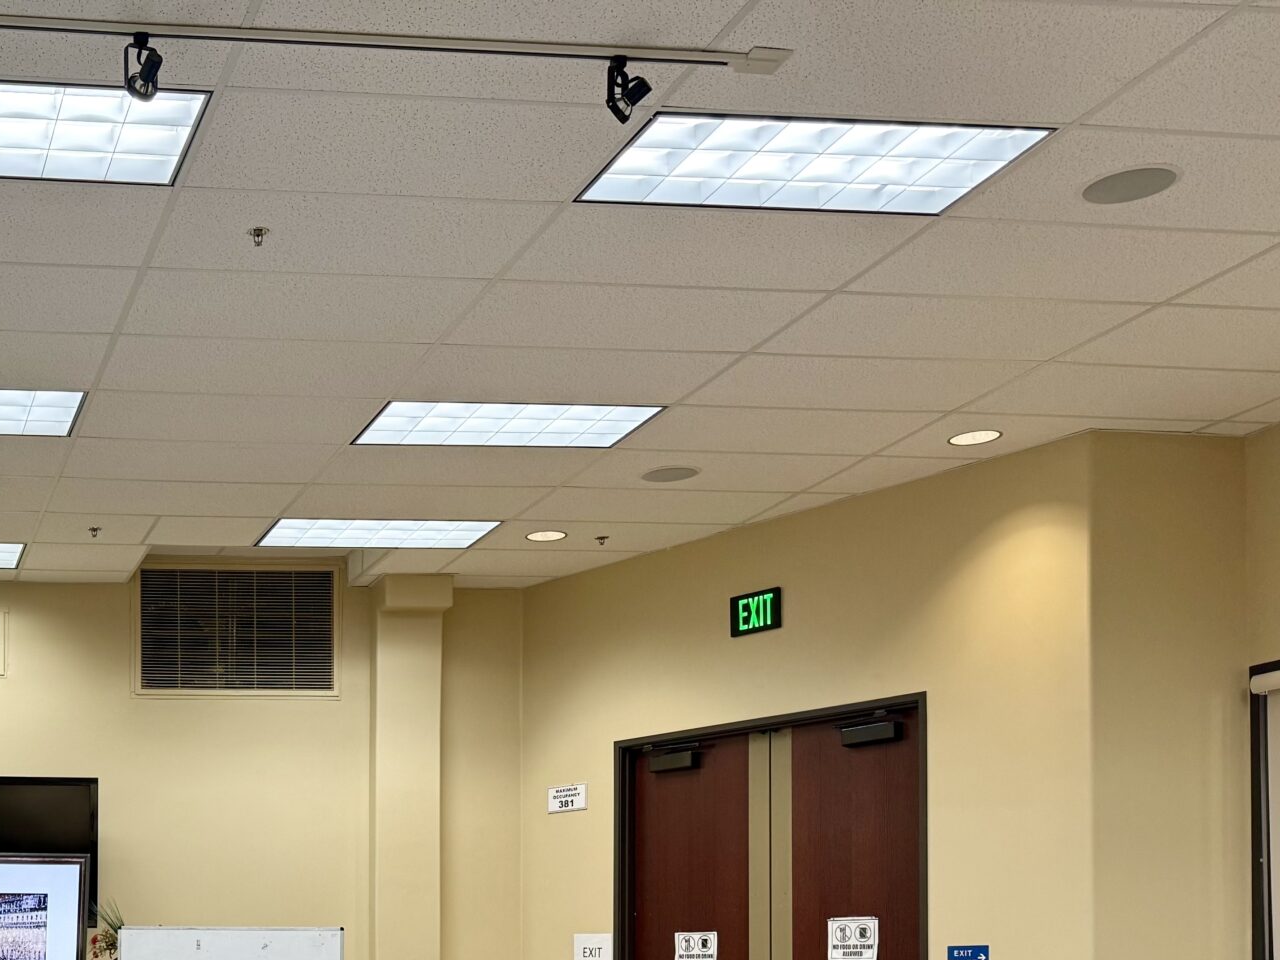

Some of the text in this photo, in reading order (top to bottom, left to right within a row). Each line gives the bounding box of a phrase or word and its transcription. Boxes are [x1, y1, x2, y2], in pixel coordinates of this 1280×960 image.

[738, 592, 774, 631] EXIT
[558, 799, 574, 809] 381
[582, 946, 603, 958] EXIT
[953, 949, 973, 957] EXIT
